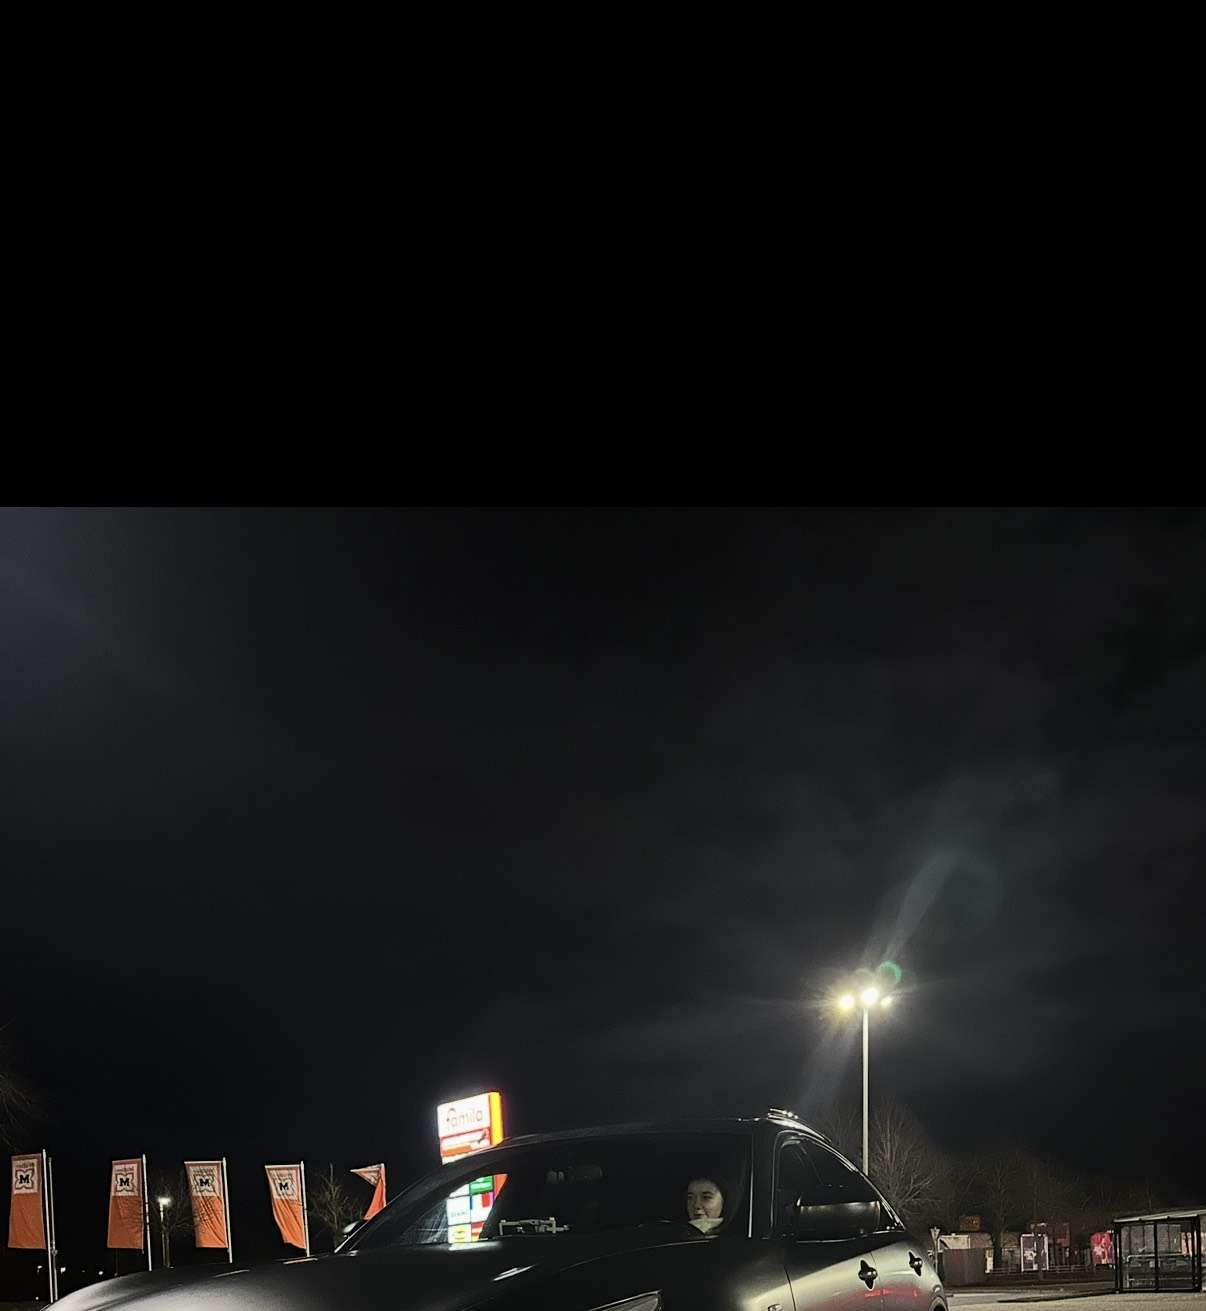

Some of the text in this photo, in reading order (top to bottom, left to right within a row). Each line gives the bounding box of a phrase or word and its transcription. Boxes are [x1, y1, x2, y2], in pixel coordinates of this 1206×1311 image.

[19, 1174, 30, 1184] M
[119, 1178, 130, 1187] M
[199, 1178, 210, 1187] M
[279, 1182, 289, 1191] M
